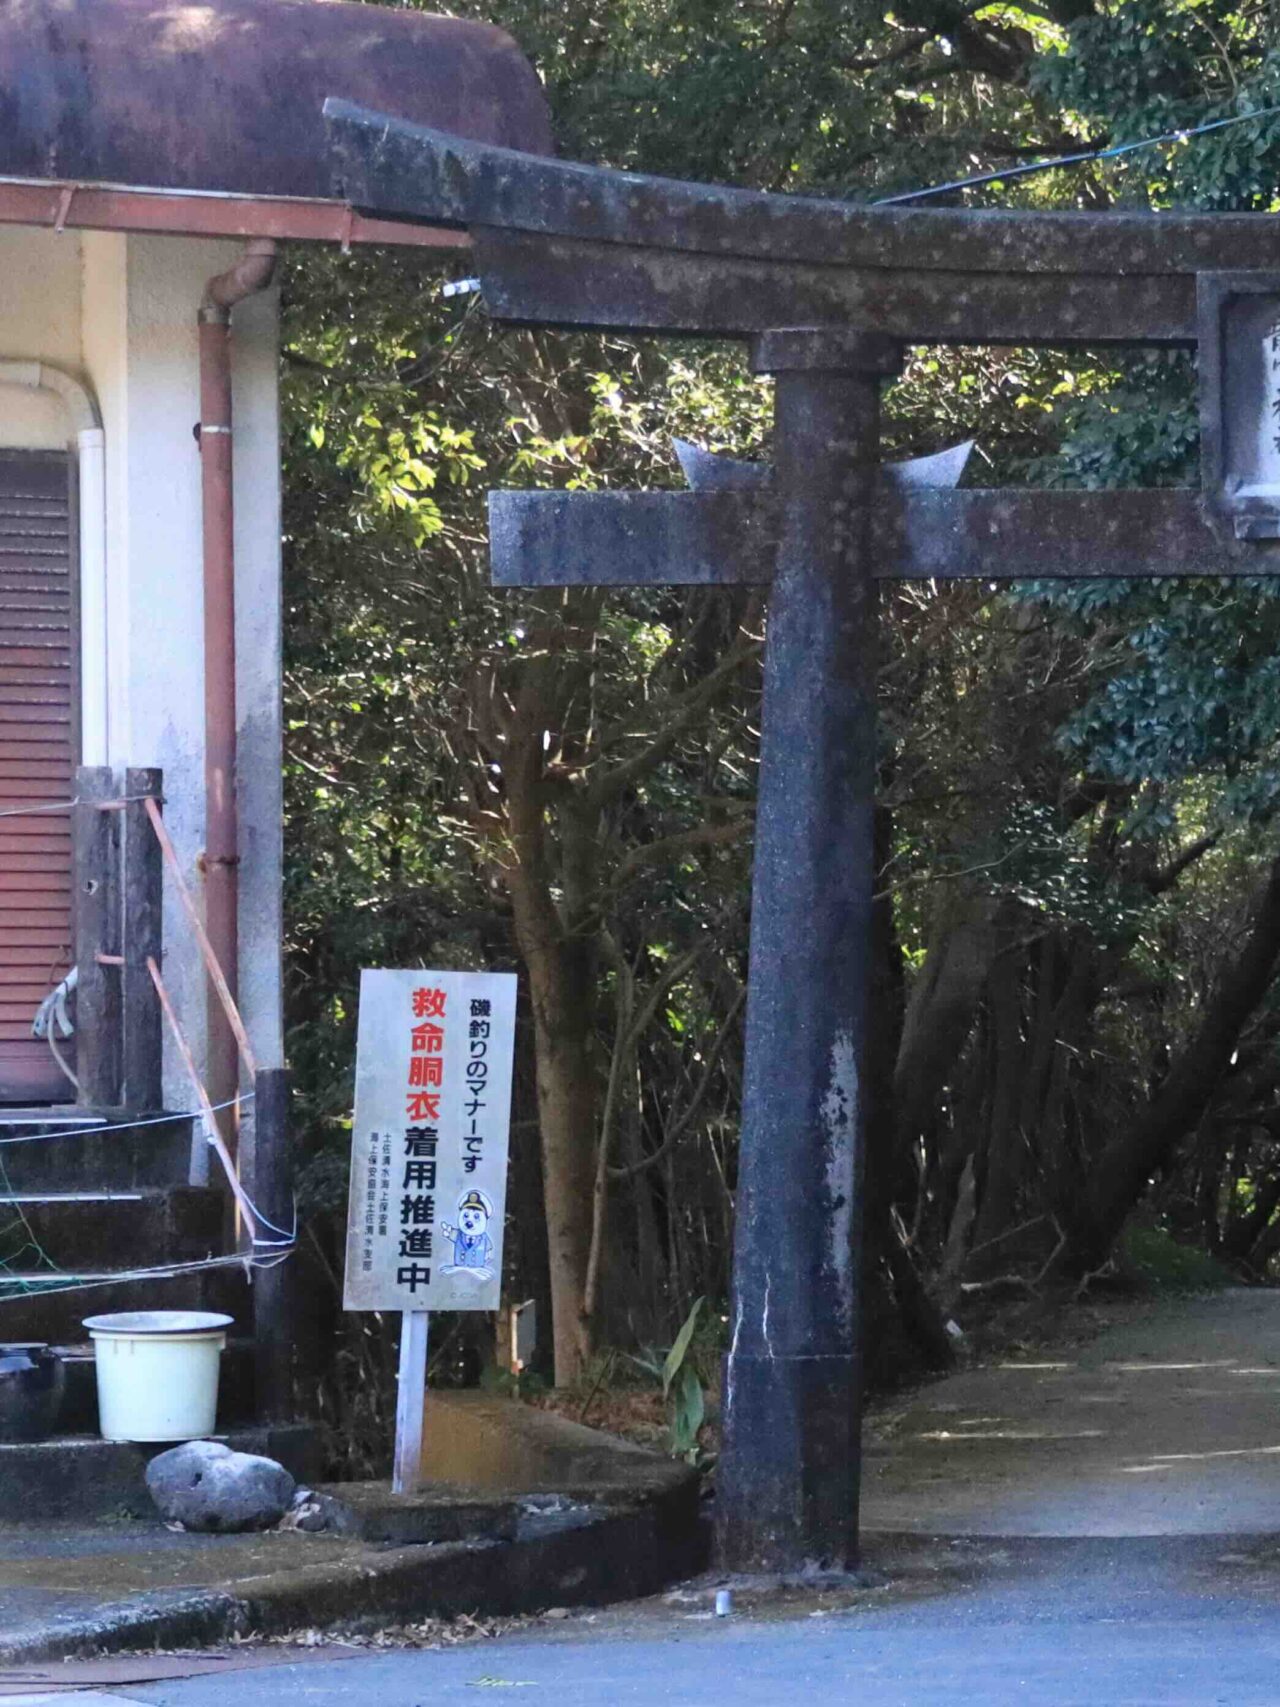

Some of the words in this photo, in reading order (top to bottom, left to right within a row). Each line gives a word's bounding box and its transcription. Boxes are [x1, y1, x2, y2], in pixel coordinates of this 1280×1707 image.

[397, 988, 447, 1293] 救命胴衣着用推進中
[462, 999, 491, 1173] 磯釣りのマナーです
